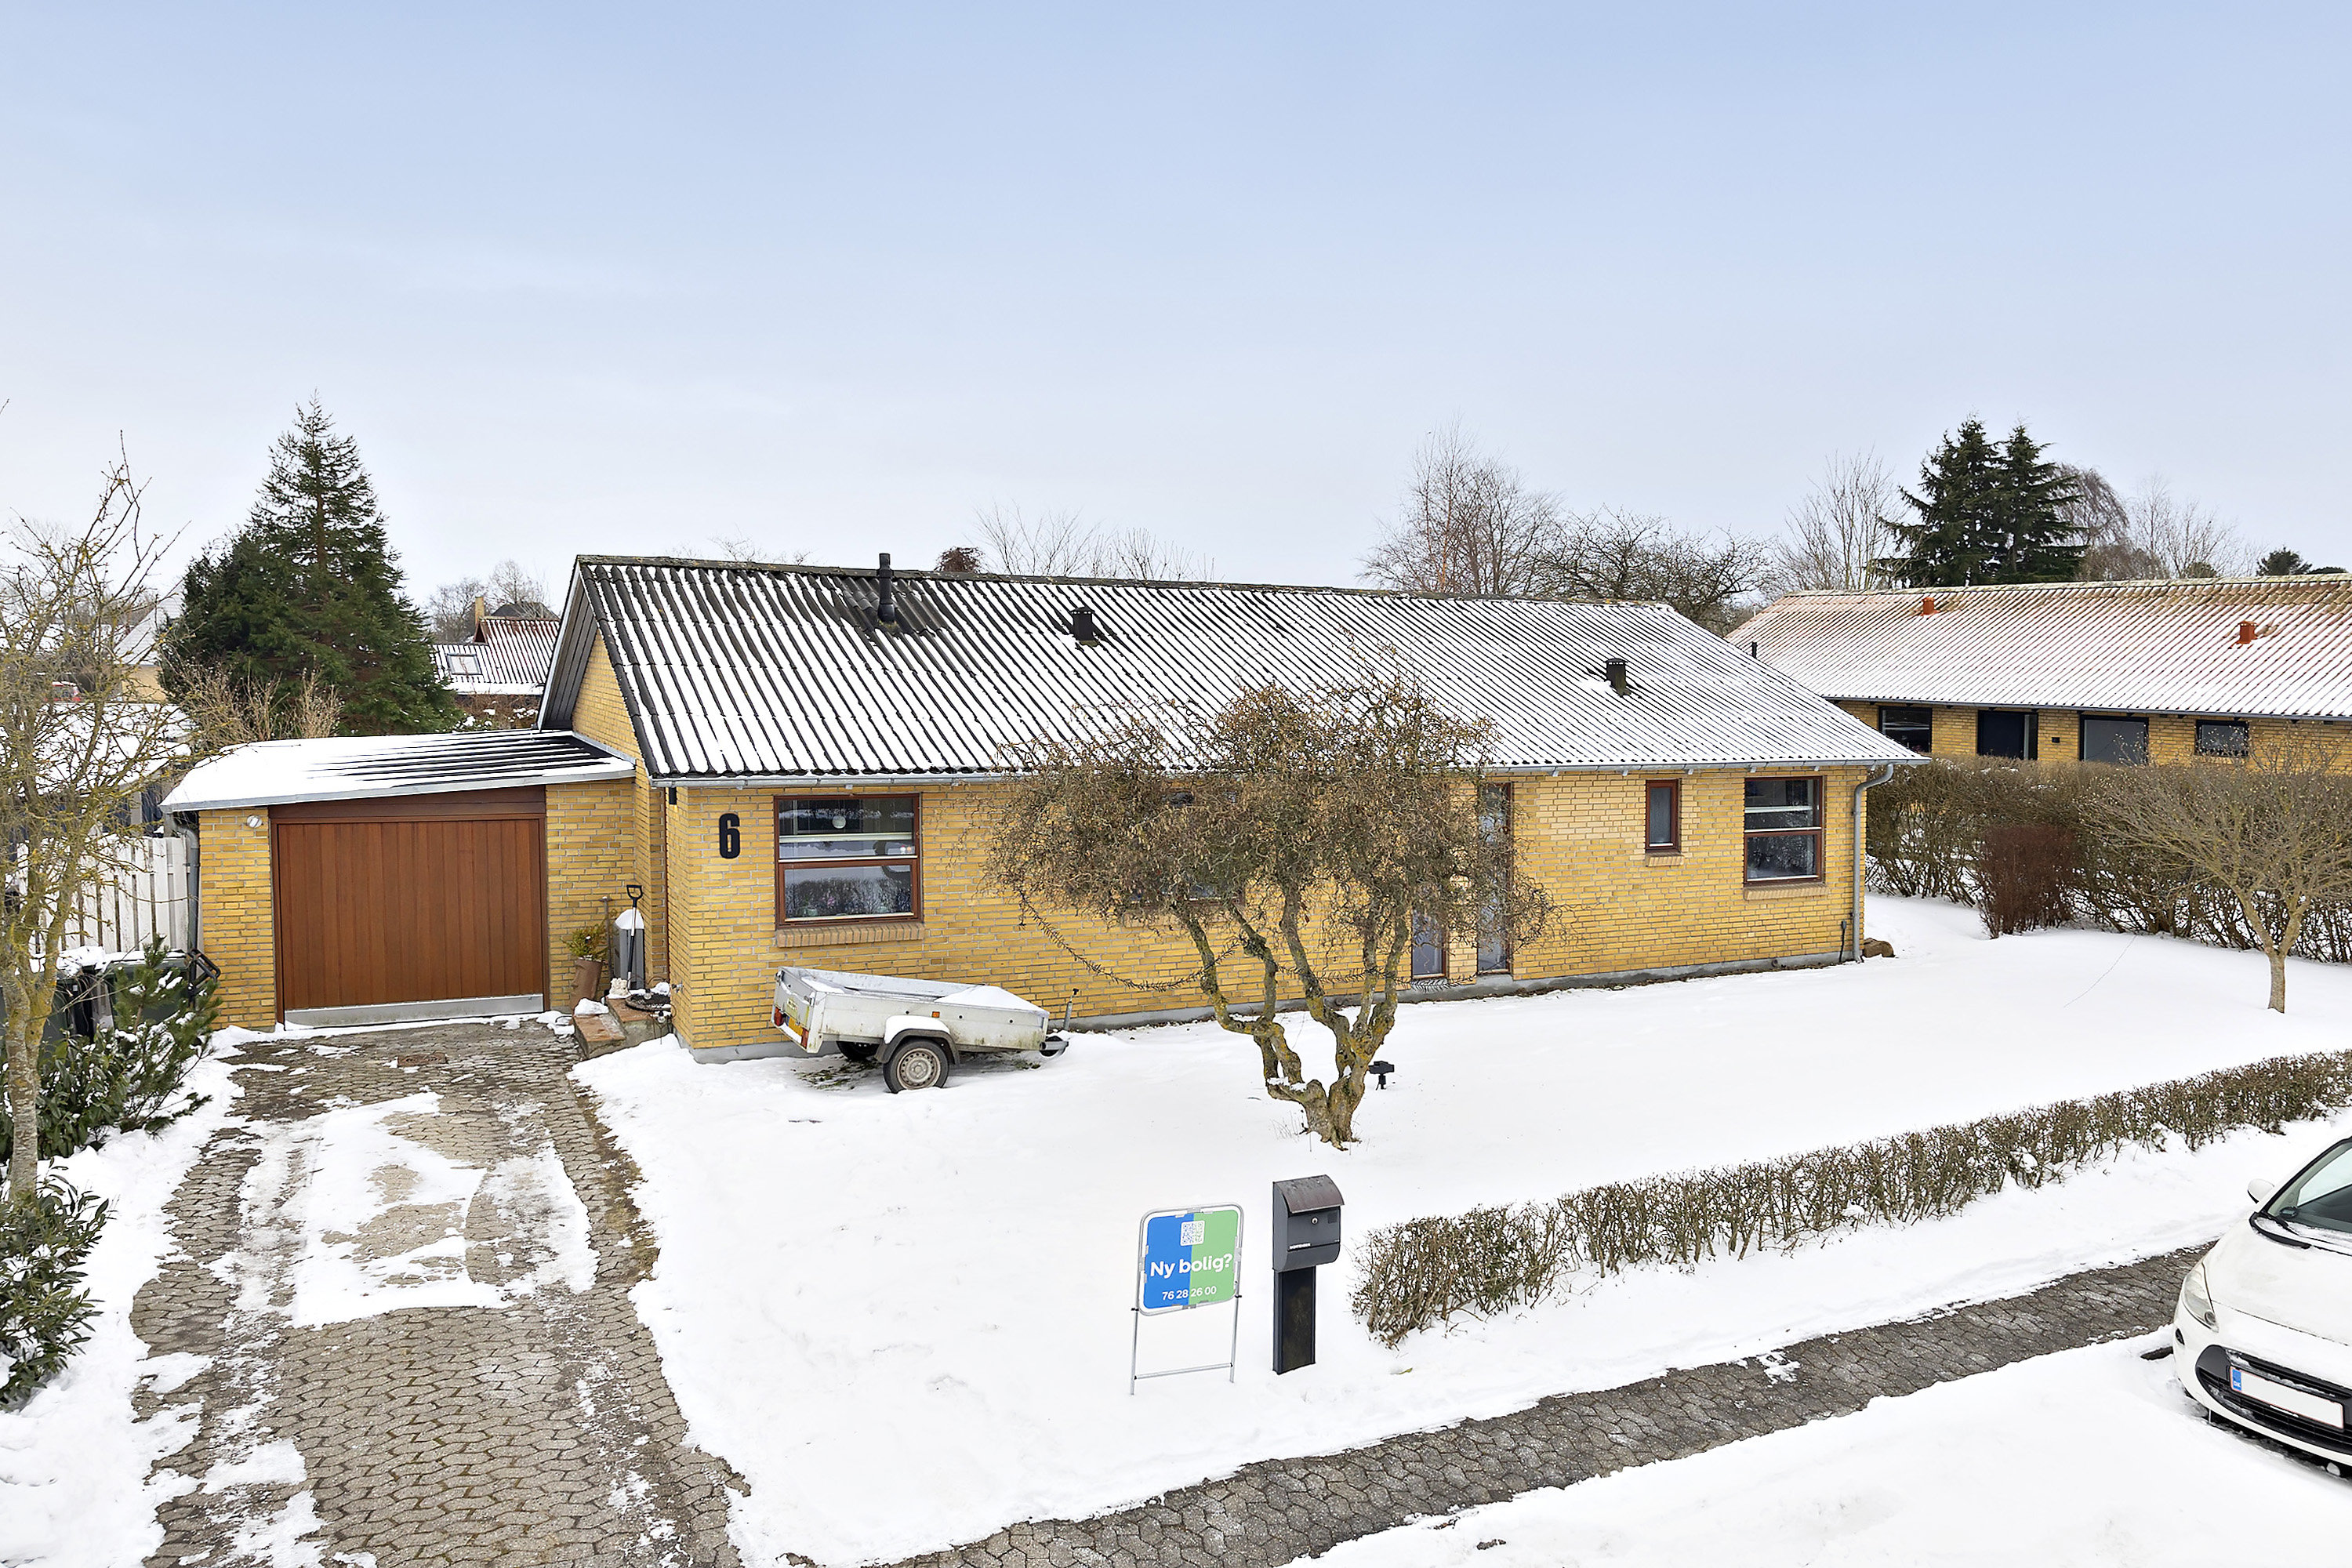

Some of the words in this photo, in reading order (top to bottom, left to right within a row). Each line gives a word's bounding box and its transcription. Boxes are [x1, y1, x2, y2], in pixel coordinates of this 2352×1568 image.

[719, 813, 740, 859] 6
[1150, 1261, 1176, 1279] Ny
[1178, 1253, 1232, 1273] bolig?
[1162, 1291, 1174, 1300] 76
[1176, 1289, 1189, 1299] 28
[1190, 1287, 1203, 1298] 26
[1204, 1286, 1217, 1295] 00
